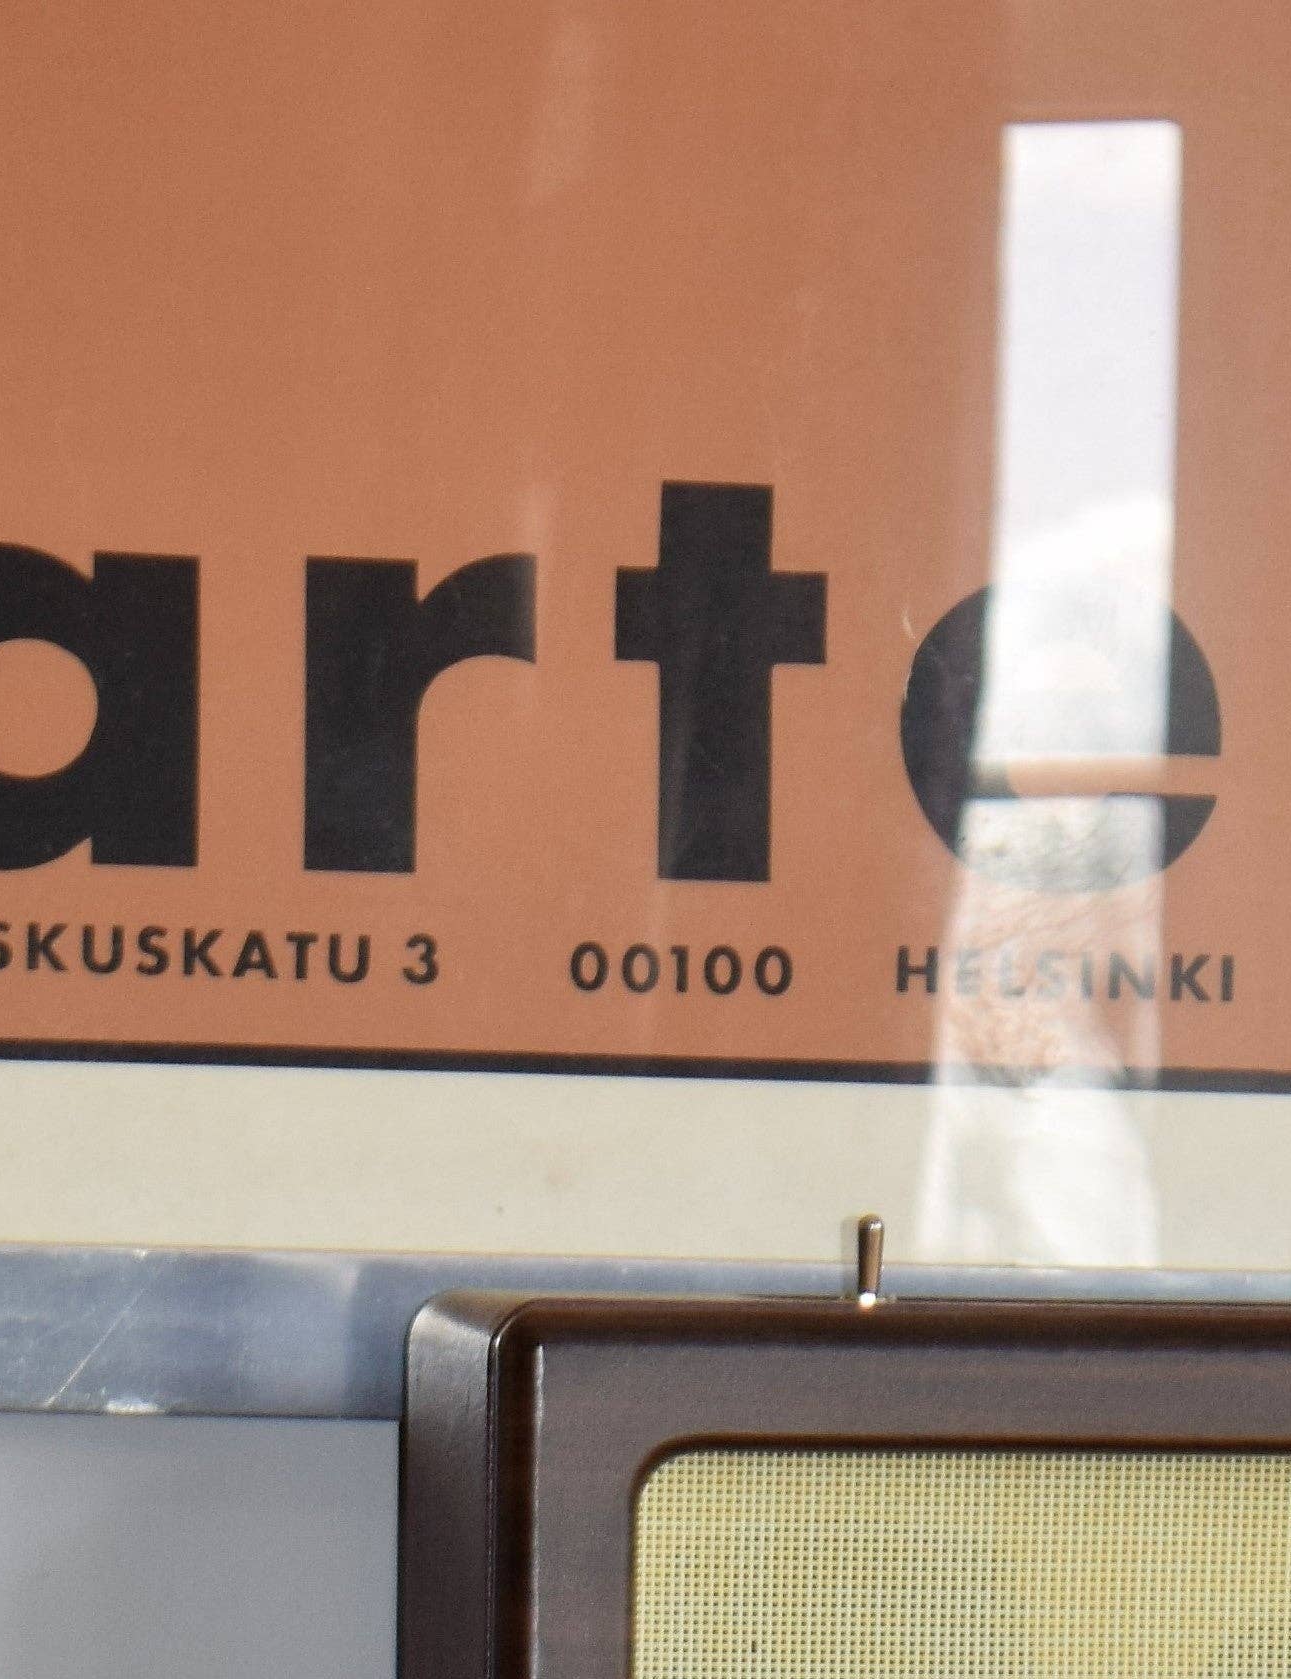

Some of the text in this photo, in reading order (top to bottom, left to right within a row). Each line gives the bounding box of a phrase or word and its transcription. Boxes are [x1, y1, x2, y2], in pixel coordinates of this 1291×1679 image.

[401, 934, 440, 986] 3
[569, 941, 793, 997] 00100
[896, 946, 1234, 1004] HELSINKI
